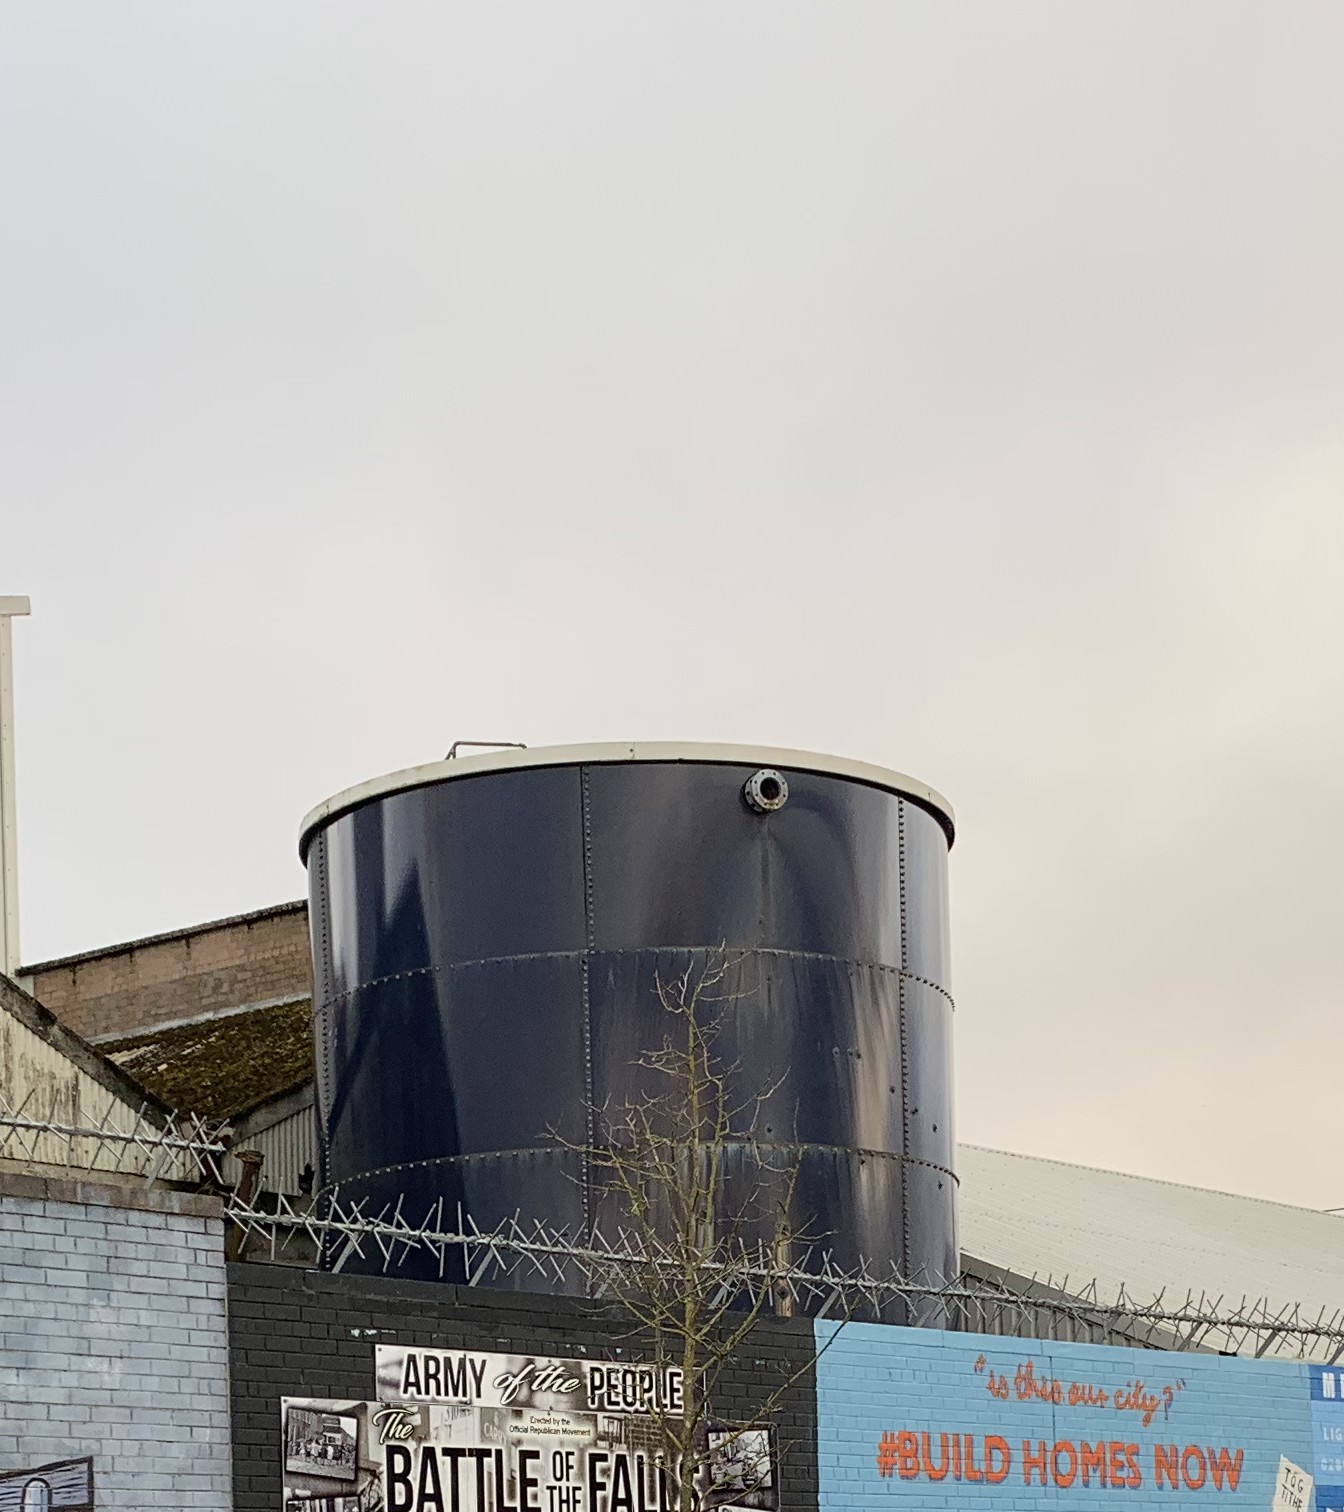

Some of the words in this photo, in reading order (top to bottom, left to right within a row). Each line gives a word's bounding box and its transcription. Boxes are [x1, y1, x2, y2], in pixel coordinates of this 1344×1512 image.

[402, 1353, 488, 1399] ARMY
[492, 1364, 529, 1405] of
[533, 1365, 582, 1394] the
[587, 1366, 684, 1411] PEOPLE
[1013, 1359, 1064, 1406] this
[1067, 1381, 1109, 1409] our
[372, 1408, 415, 1444] The
[553, 1416, 560, 1426] by
[562, 1417, 571, 1425] the
[552, 1451, 575, 1482] OF
[876, 1430, 1011, 1483] #BUILD
[1021, 1439, 1142, 1488] HOMES
[1154, 1443, 1244, 1492] NOW
